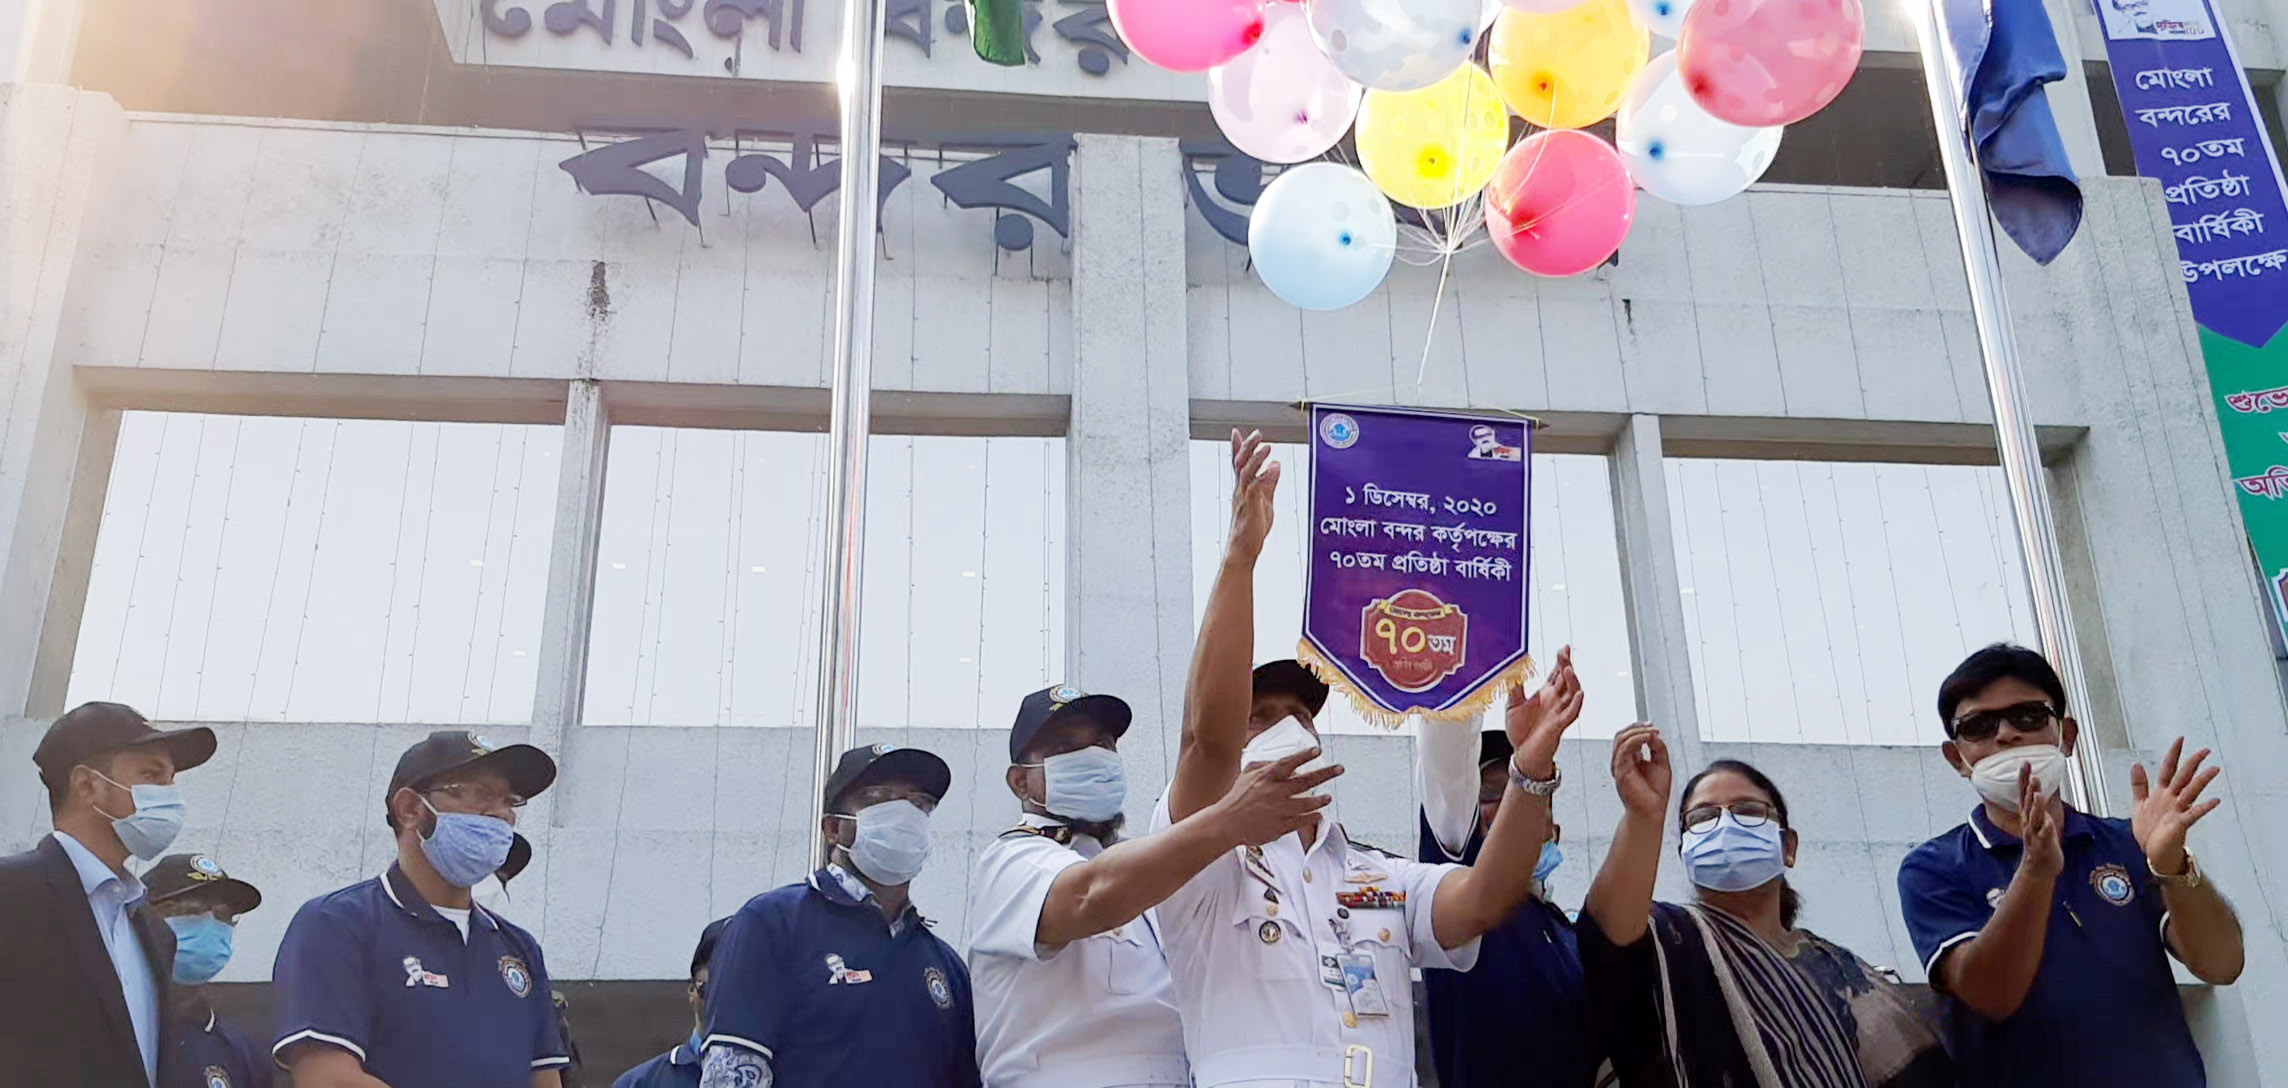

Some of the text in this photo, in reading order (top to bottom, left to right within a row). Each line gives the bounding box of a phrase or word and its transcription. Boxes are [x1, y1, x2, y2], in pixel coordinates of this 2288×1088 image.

[2135, 67, 2213, 90] মোংলা
[2134, 102, 2231, 128] বন্দরের
[2161, 138, 2245, 166] ৭০তম
[2165, 169, 2250, 206] প্রতিষ্ঠা
[2173, 208, 2264, 244] বার্ষিকী
[2180, 249, 2288, 283] উপলক্ষে
[1345, 482, 1497, 517] ১ ডিসেম্বর, ২০২০
[1320, 517, 1518, 552] মোংলা বন্দর কর্তৃপক্ষের
[1330, 550, 1512, 581] ৭০তম প্রতিষ্ঠা বার্ষিকী
